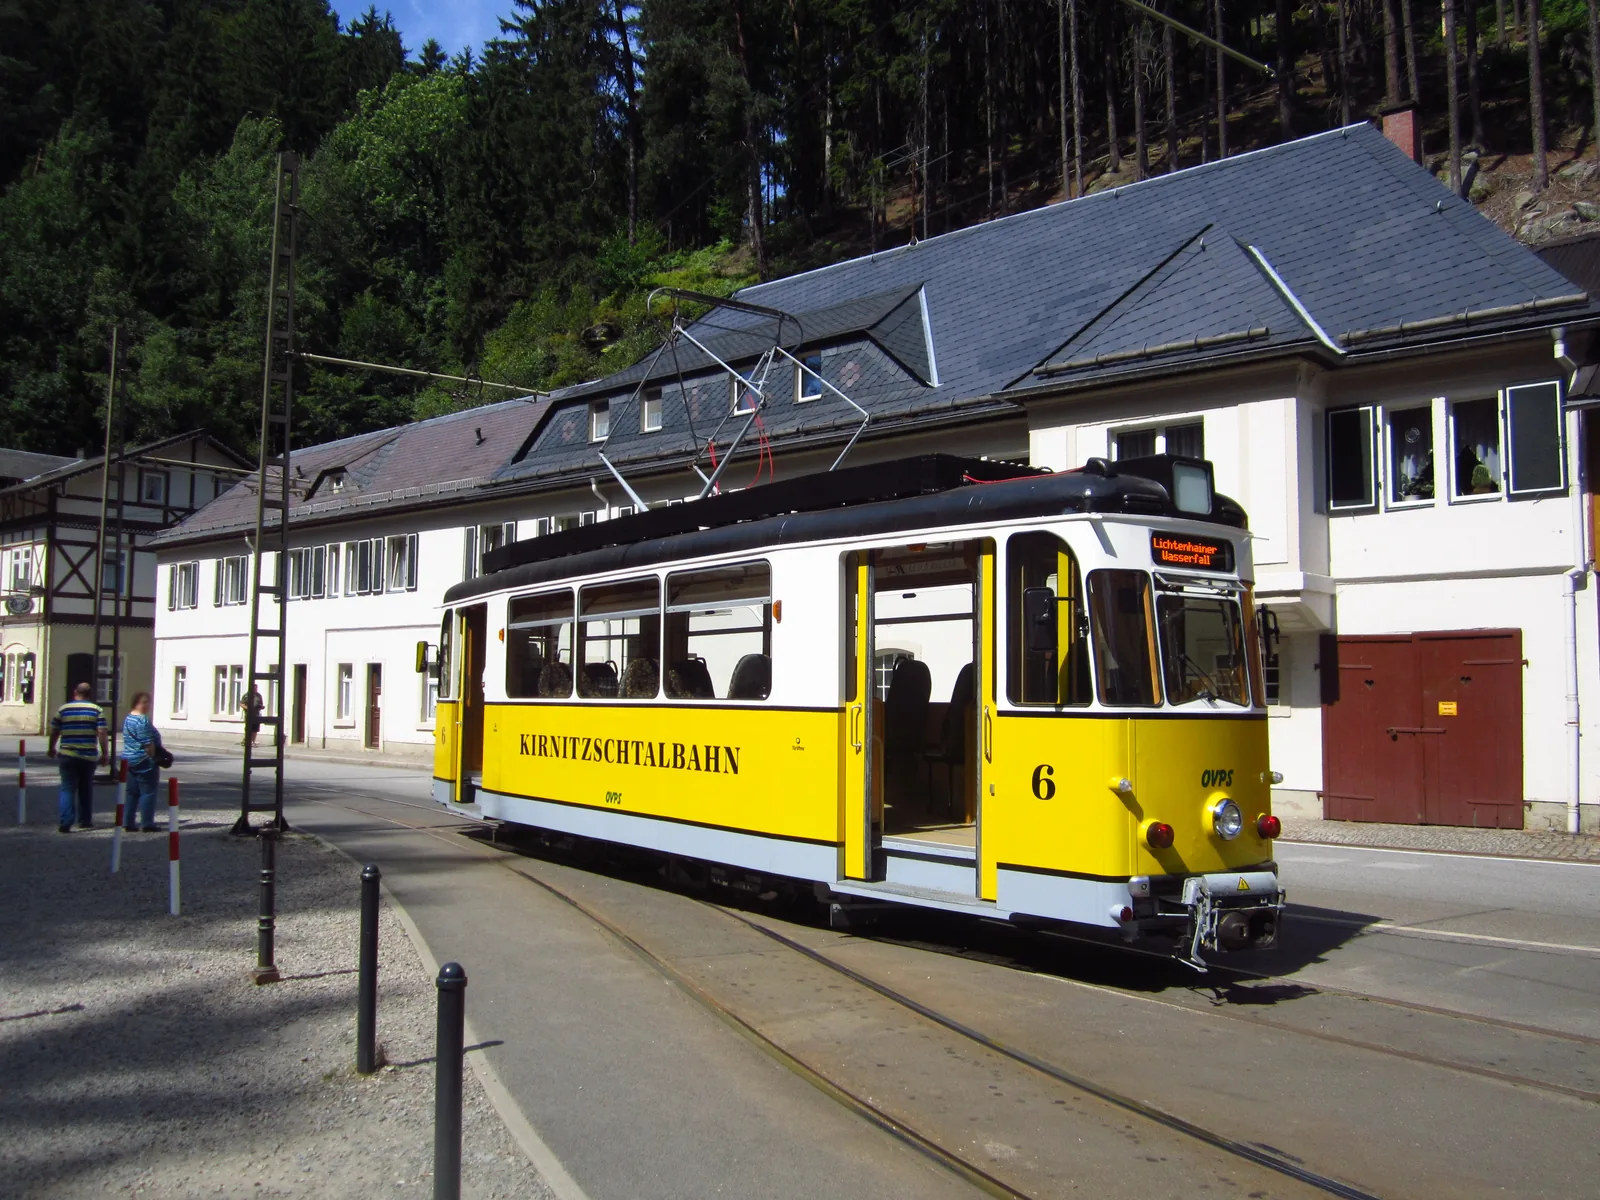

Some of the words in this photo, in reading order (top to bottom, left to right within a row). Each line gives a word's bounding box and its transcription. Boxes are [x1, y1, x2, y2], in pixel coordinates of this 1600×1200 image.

[1153, 538, 1217, 554] Lichtenhainer
[1161, 550, 1211, 565] Wasserfall
[520, 733, 741, 775] KIRNITZSCHTALBAHN
[1031, 764, 1056, 801] 6
[1201, 769, 1235, 788] OVPS
